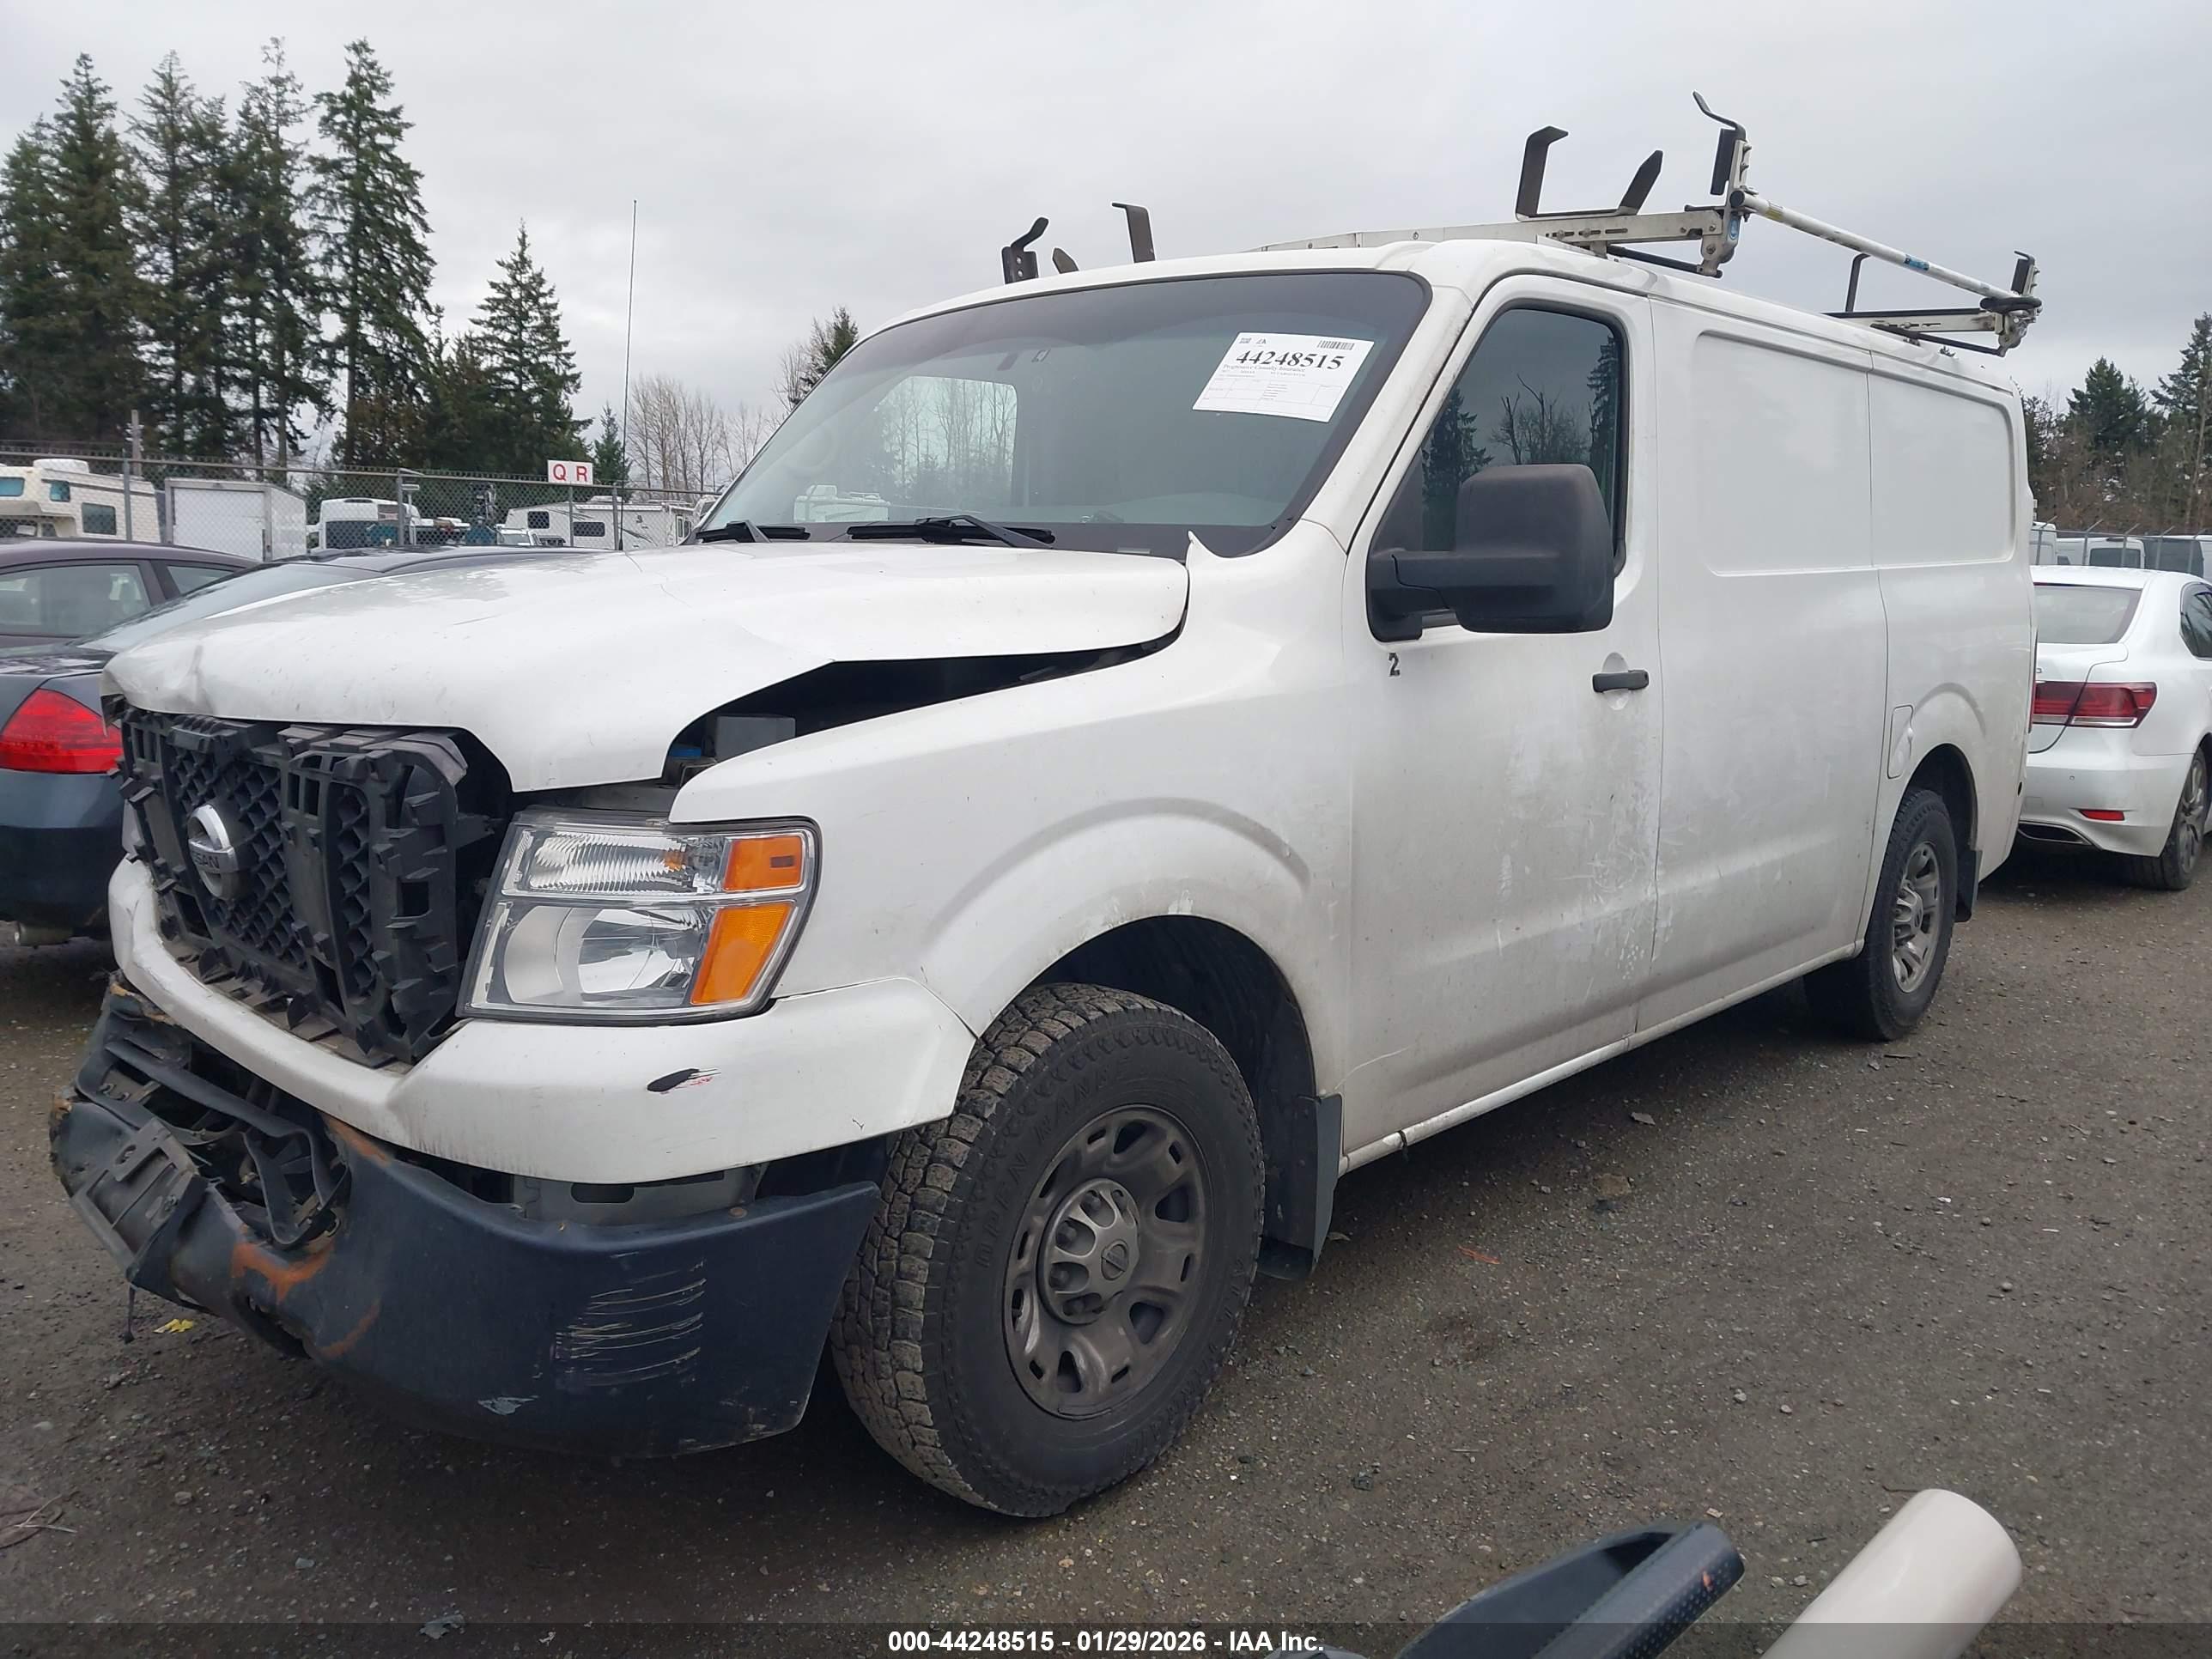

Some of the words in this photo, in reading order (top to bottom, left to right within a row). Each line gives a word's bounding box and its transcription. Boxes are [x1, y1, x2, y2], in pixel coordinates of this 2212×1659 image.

[1236, 350, 1346, 370] 44248515
[553, 464, 567, 481] Q
[576, 465, 587, 482] R
[1389, 652, 1400, 677] 2
